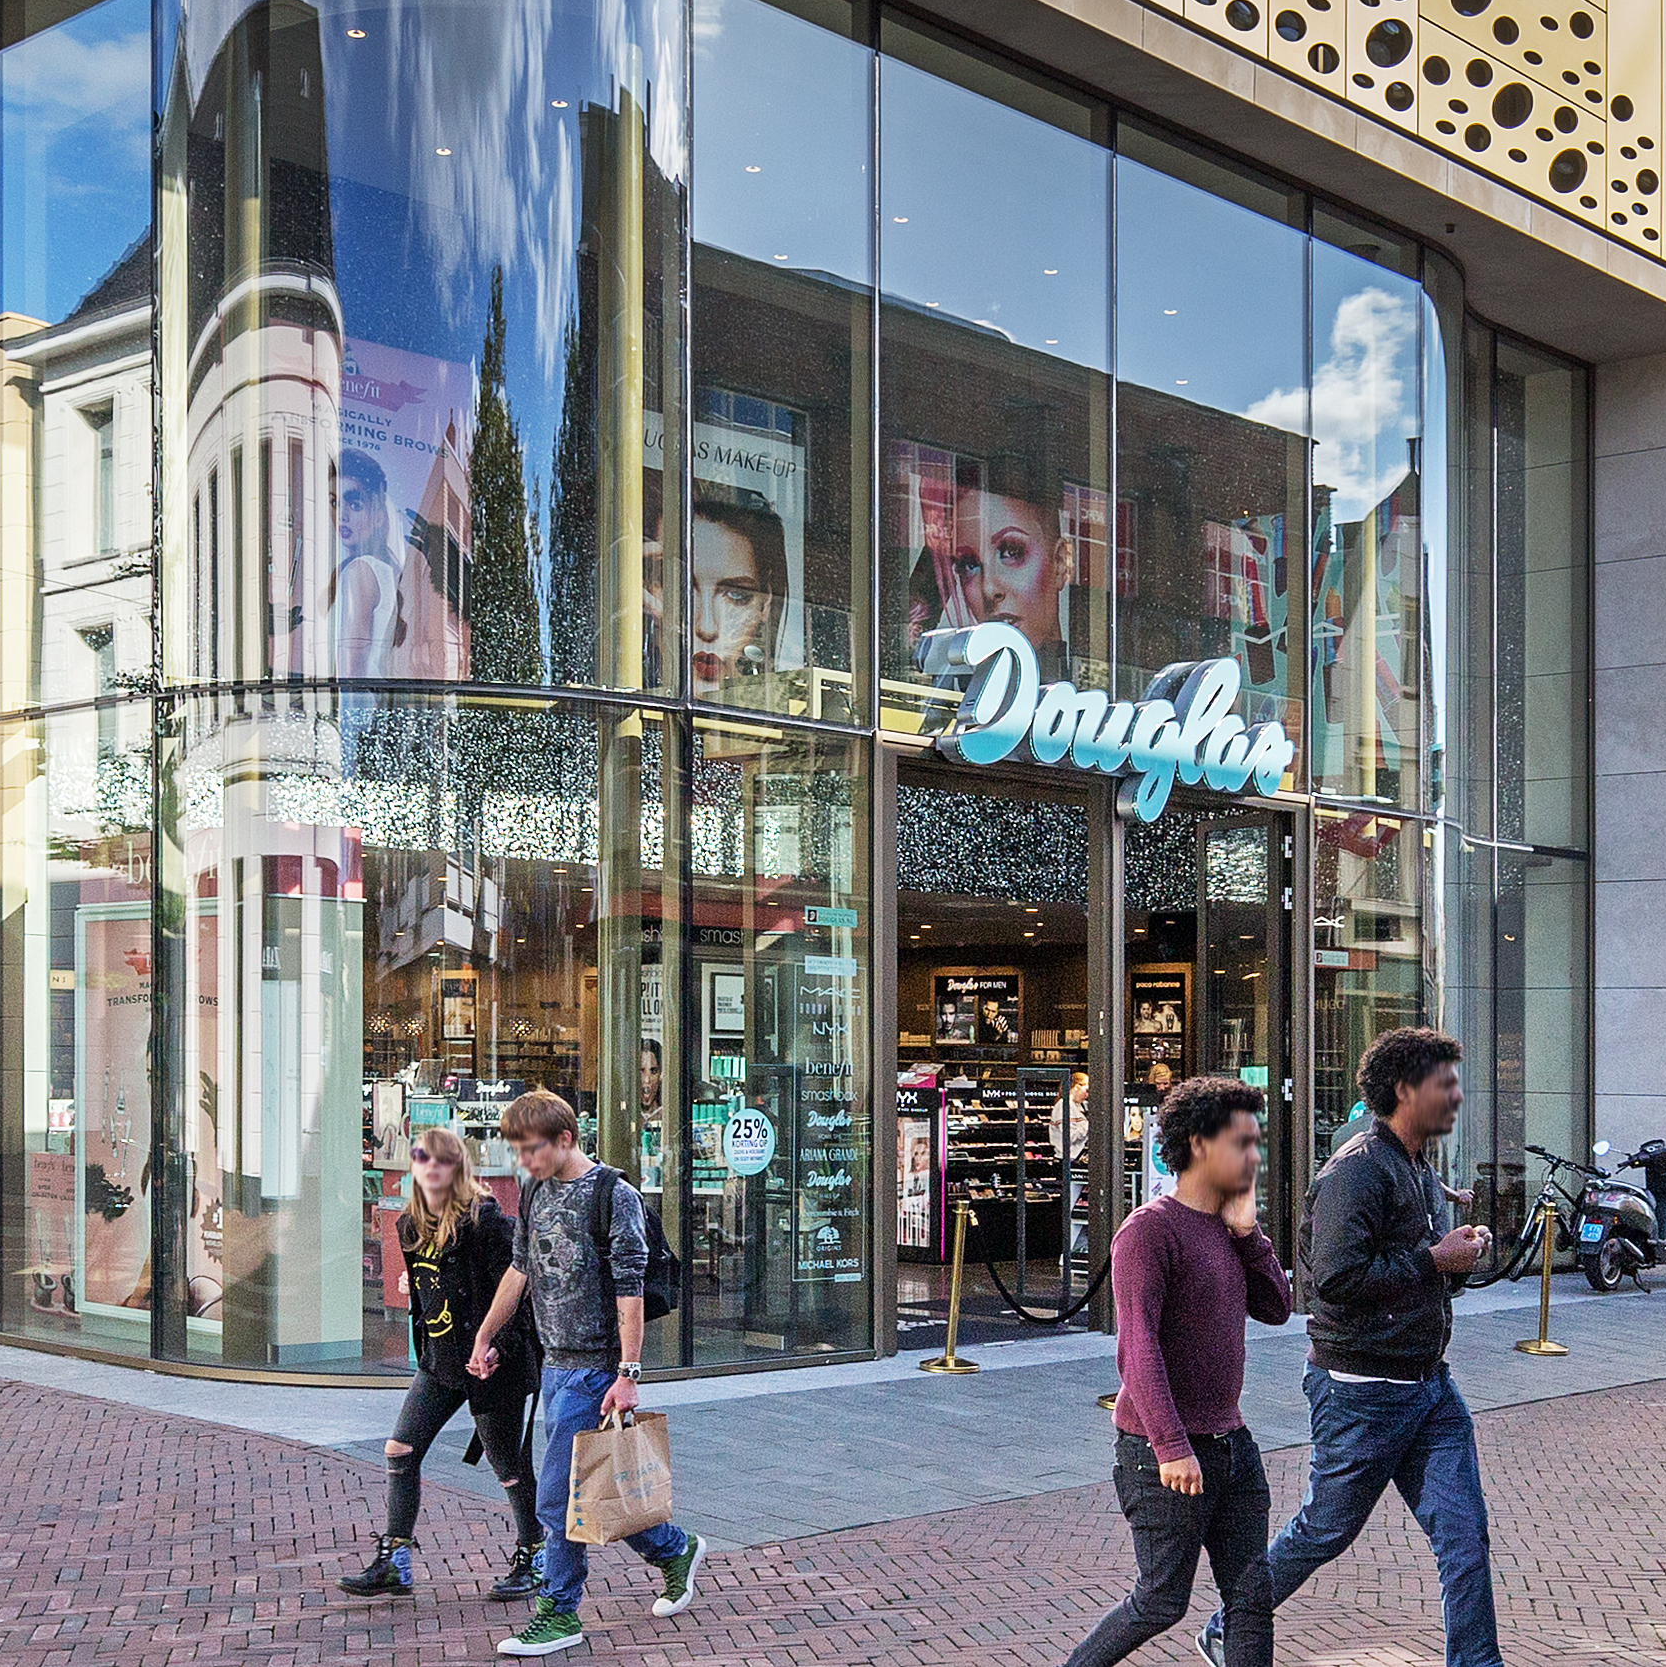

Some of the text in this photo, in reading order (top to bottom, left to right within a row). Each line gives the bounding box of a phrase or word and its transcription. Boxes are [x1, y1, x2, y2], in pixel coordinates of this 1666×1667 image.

[335, 375, 381, 400] enefit
[713, 446, 797, 479] MAKE-UP
[954, 620, 1295, 824] Douglas
[992, 981, 1007, 990] MEN
[804, 1056, 855, 1077] benefit
[731, 1118, 768, 1140] 25%
[731, 1139, 759, 1150] KORTING
[799, 1148, 828, 1162] ARIANA
[797, 1258, 860, 1271] MICHAEL KORS
